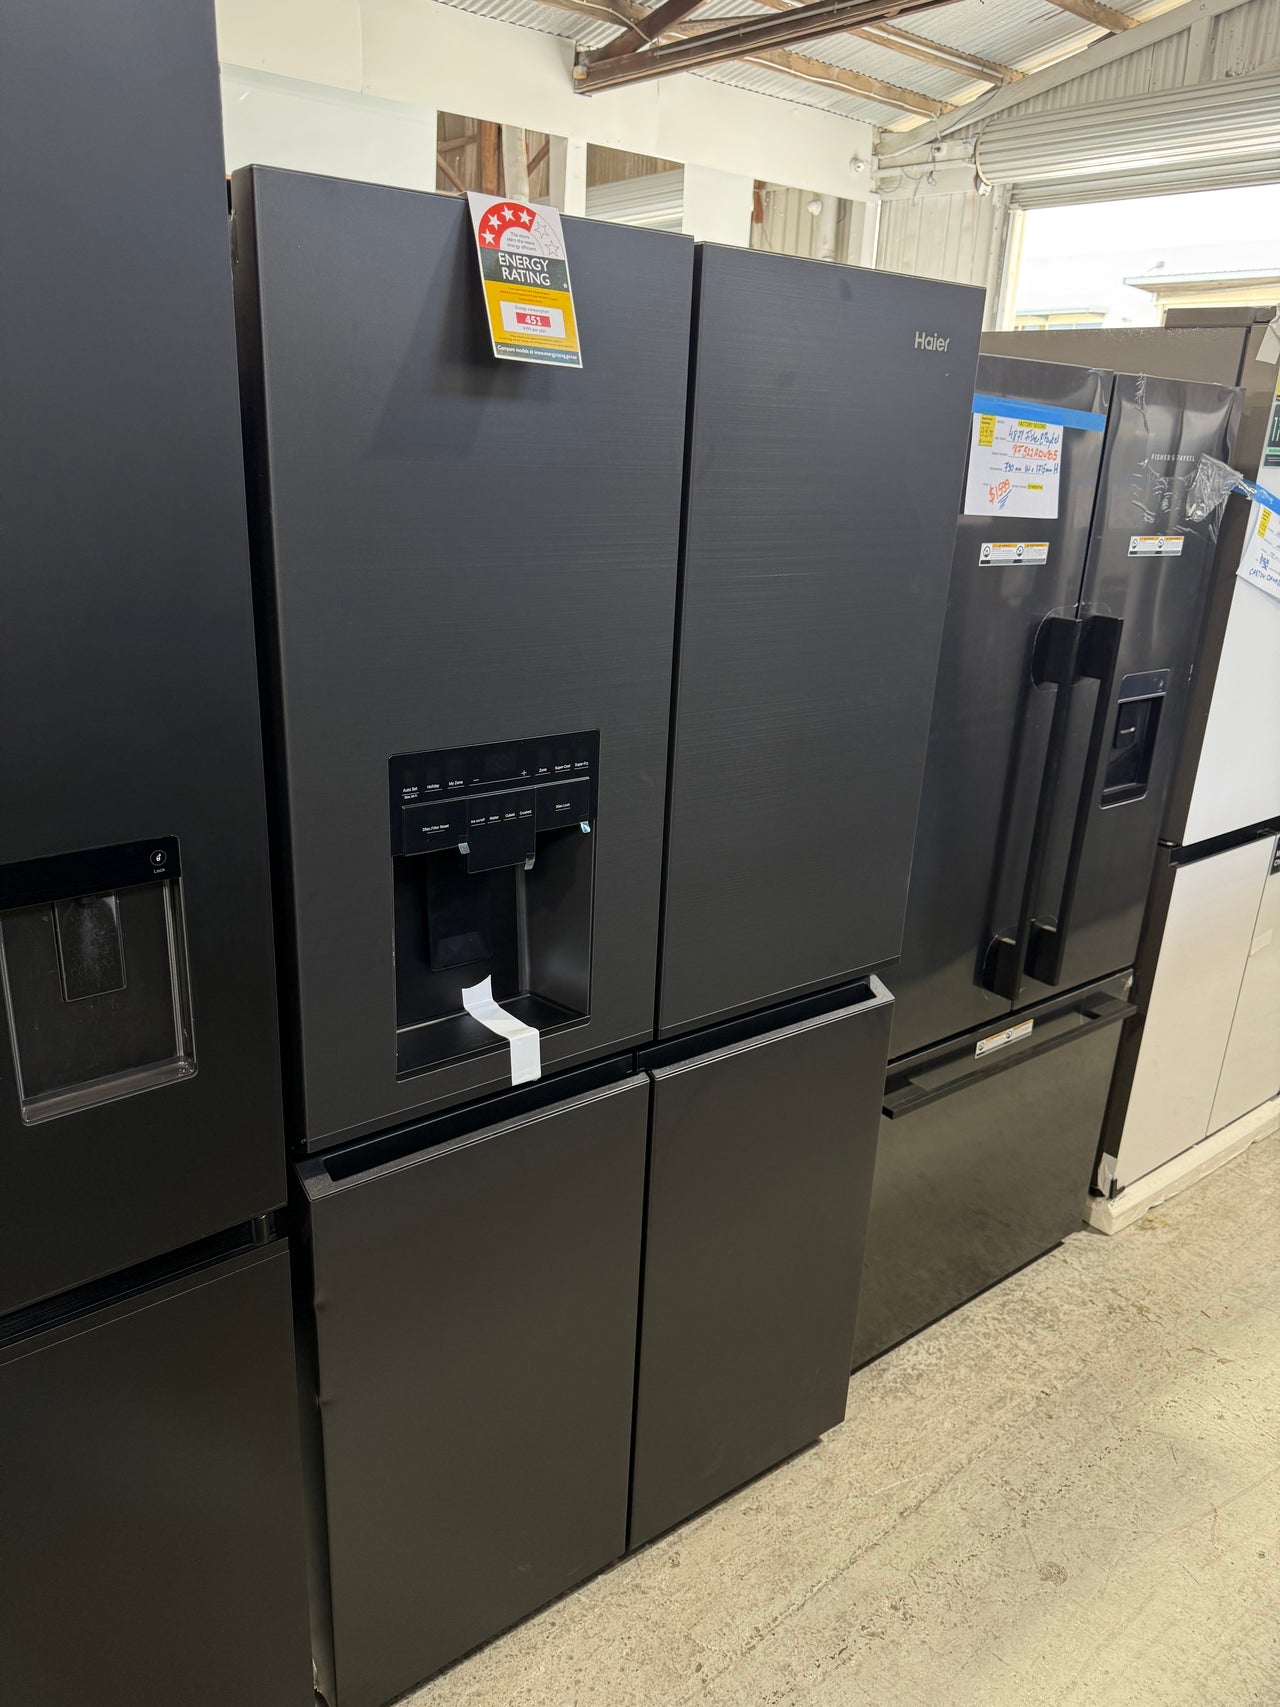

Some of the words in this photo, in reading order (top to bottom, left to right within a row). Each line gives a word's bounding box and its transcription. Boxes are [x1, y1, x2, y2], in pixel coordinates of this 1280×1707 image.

[498, 252, 549, 272] ENERGY
[502, 266, 551, 286] RATING
[525, 315, 542, 326] 451
[497, 344, 516, 354] Compare
[515, 346, 529, 354] models
[914, 331, 950, 352] Haier
